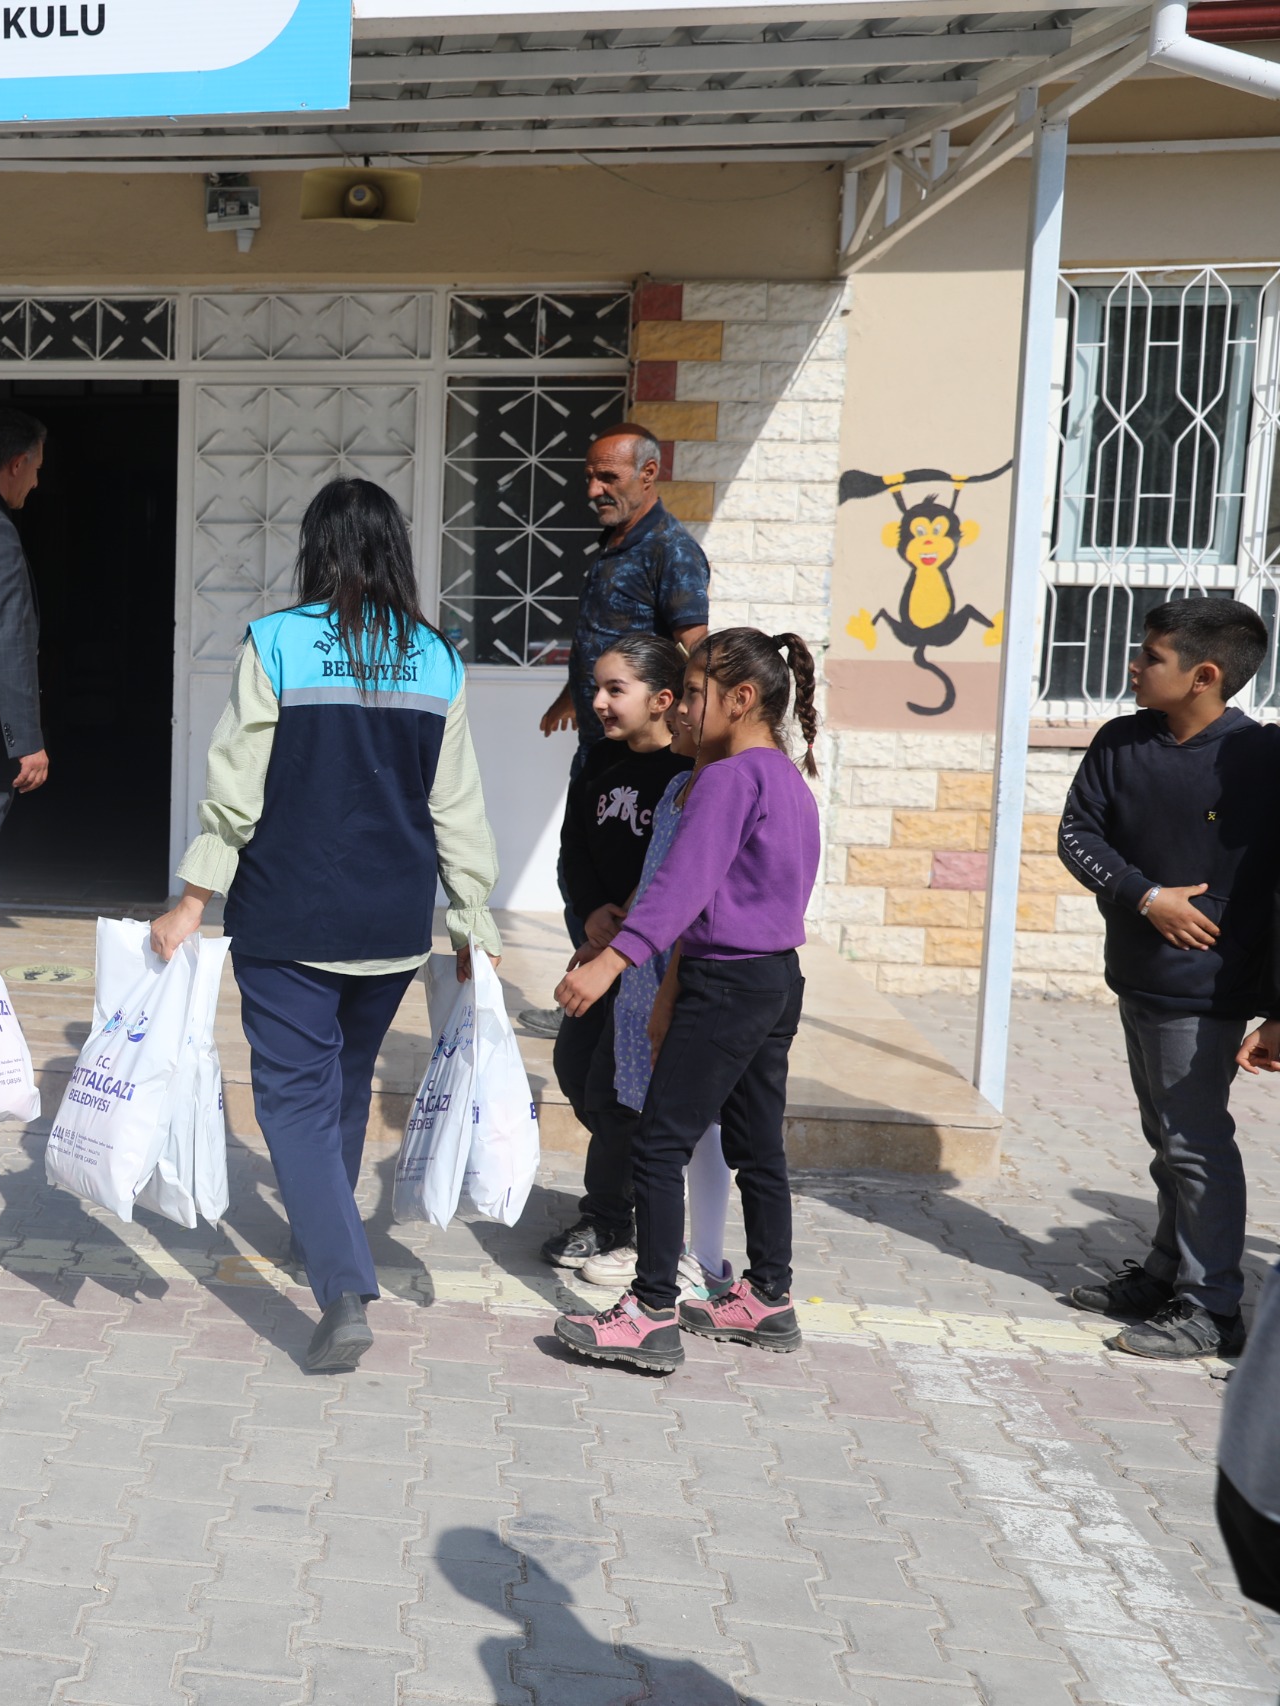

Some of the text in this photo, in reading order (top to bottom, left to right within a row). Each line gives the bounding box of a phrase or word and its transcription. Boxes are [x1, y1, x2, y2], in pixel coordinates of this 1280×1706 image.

[322, 660, 418, 682] BELDİYESİ
[72, 1066, 136, 1102] ATTALGAZİ
[68, 1088, 111, 1113] BELEDİYESİ
